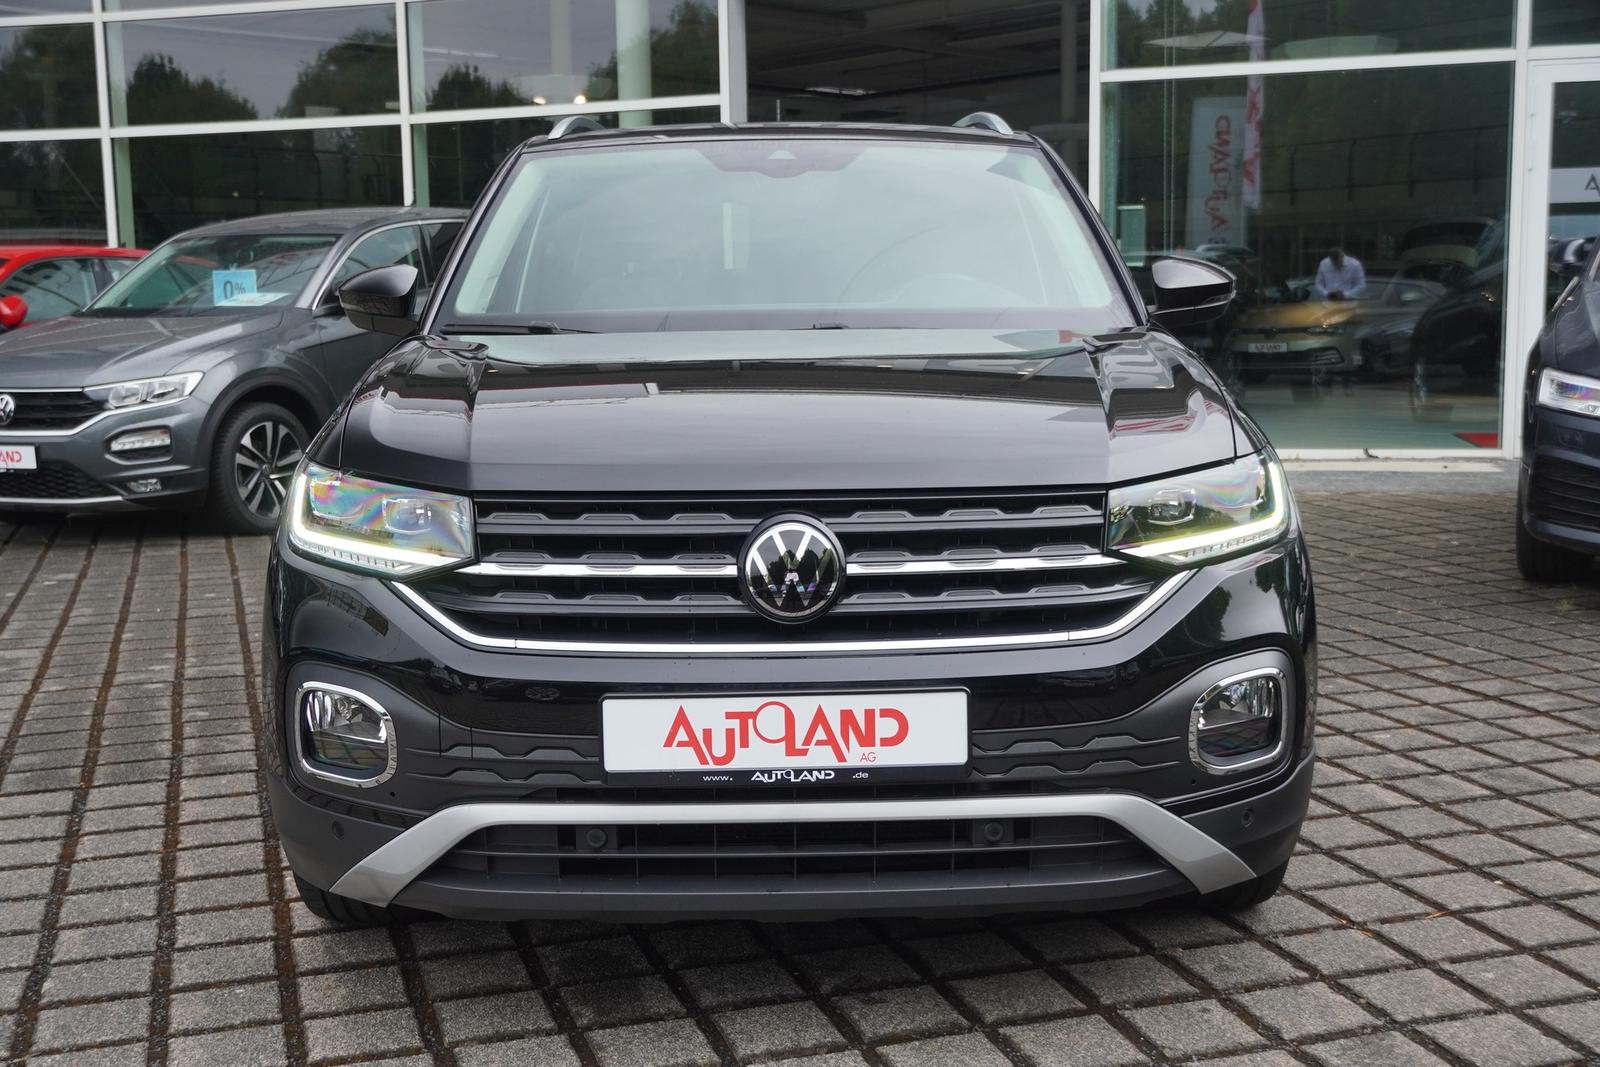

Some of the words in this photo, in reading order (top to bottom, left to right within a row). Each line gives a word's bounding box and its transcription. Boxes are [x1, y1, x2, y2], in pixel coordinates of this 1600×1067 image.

[223, 281, 246, 299] 0%
[663, 700, 910, 767] AUTOLAND
[859, 753, 877, 763] AG
[702, 774, 733, 782] www.
[750, 768, 836, 783] AUTOLAND
[852, 771, 869, 779] .de
